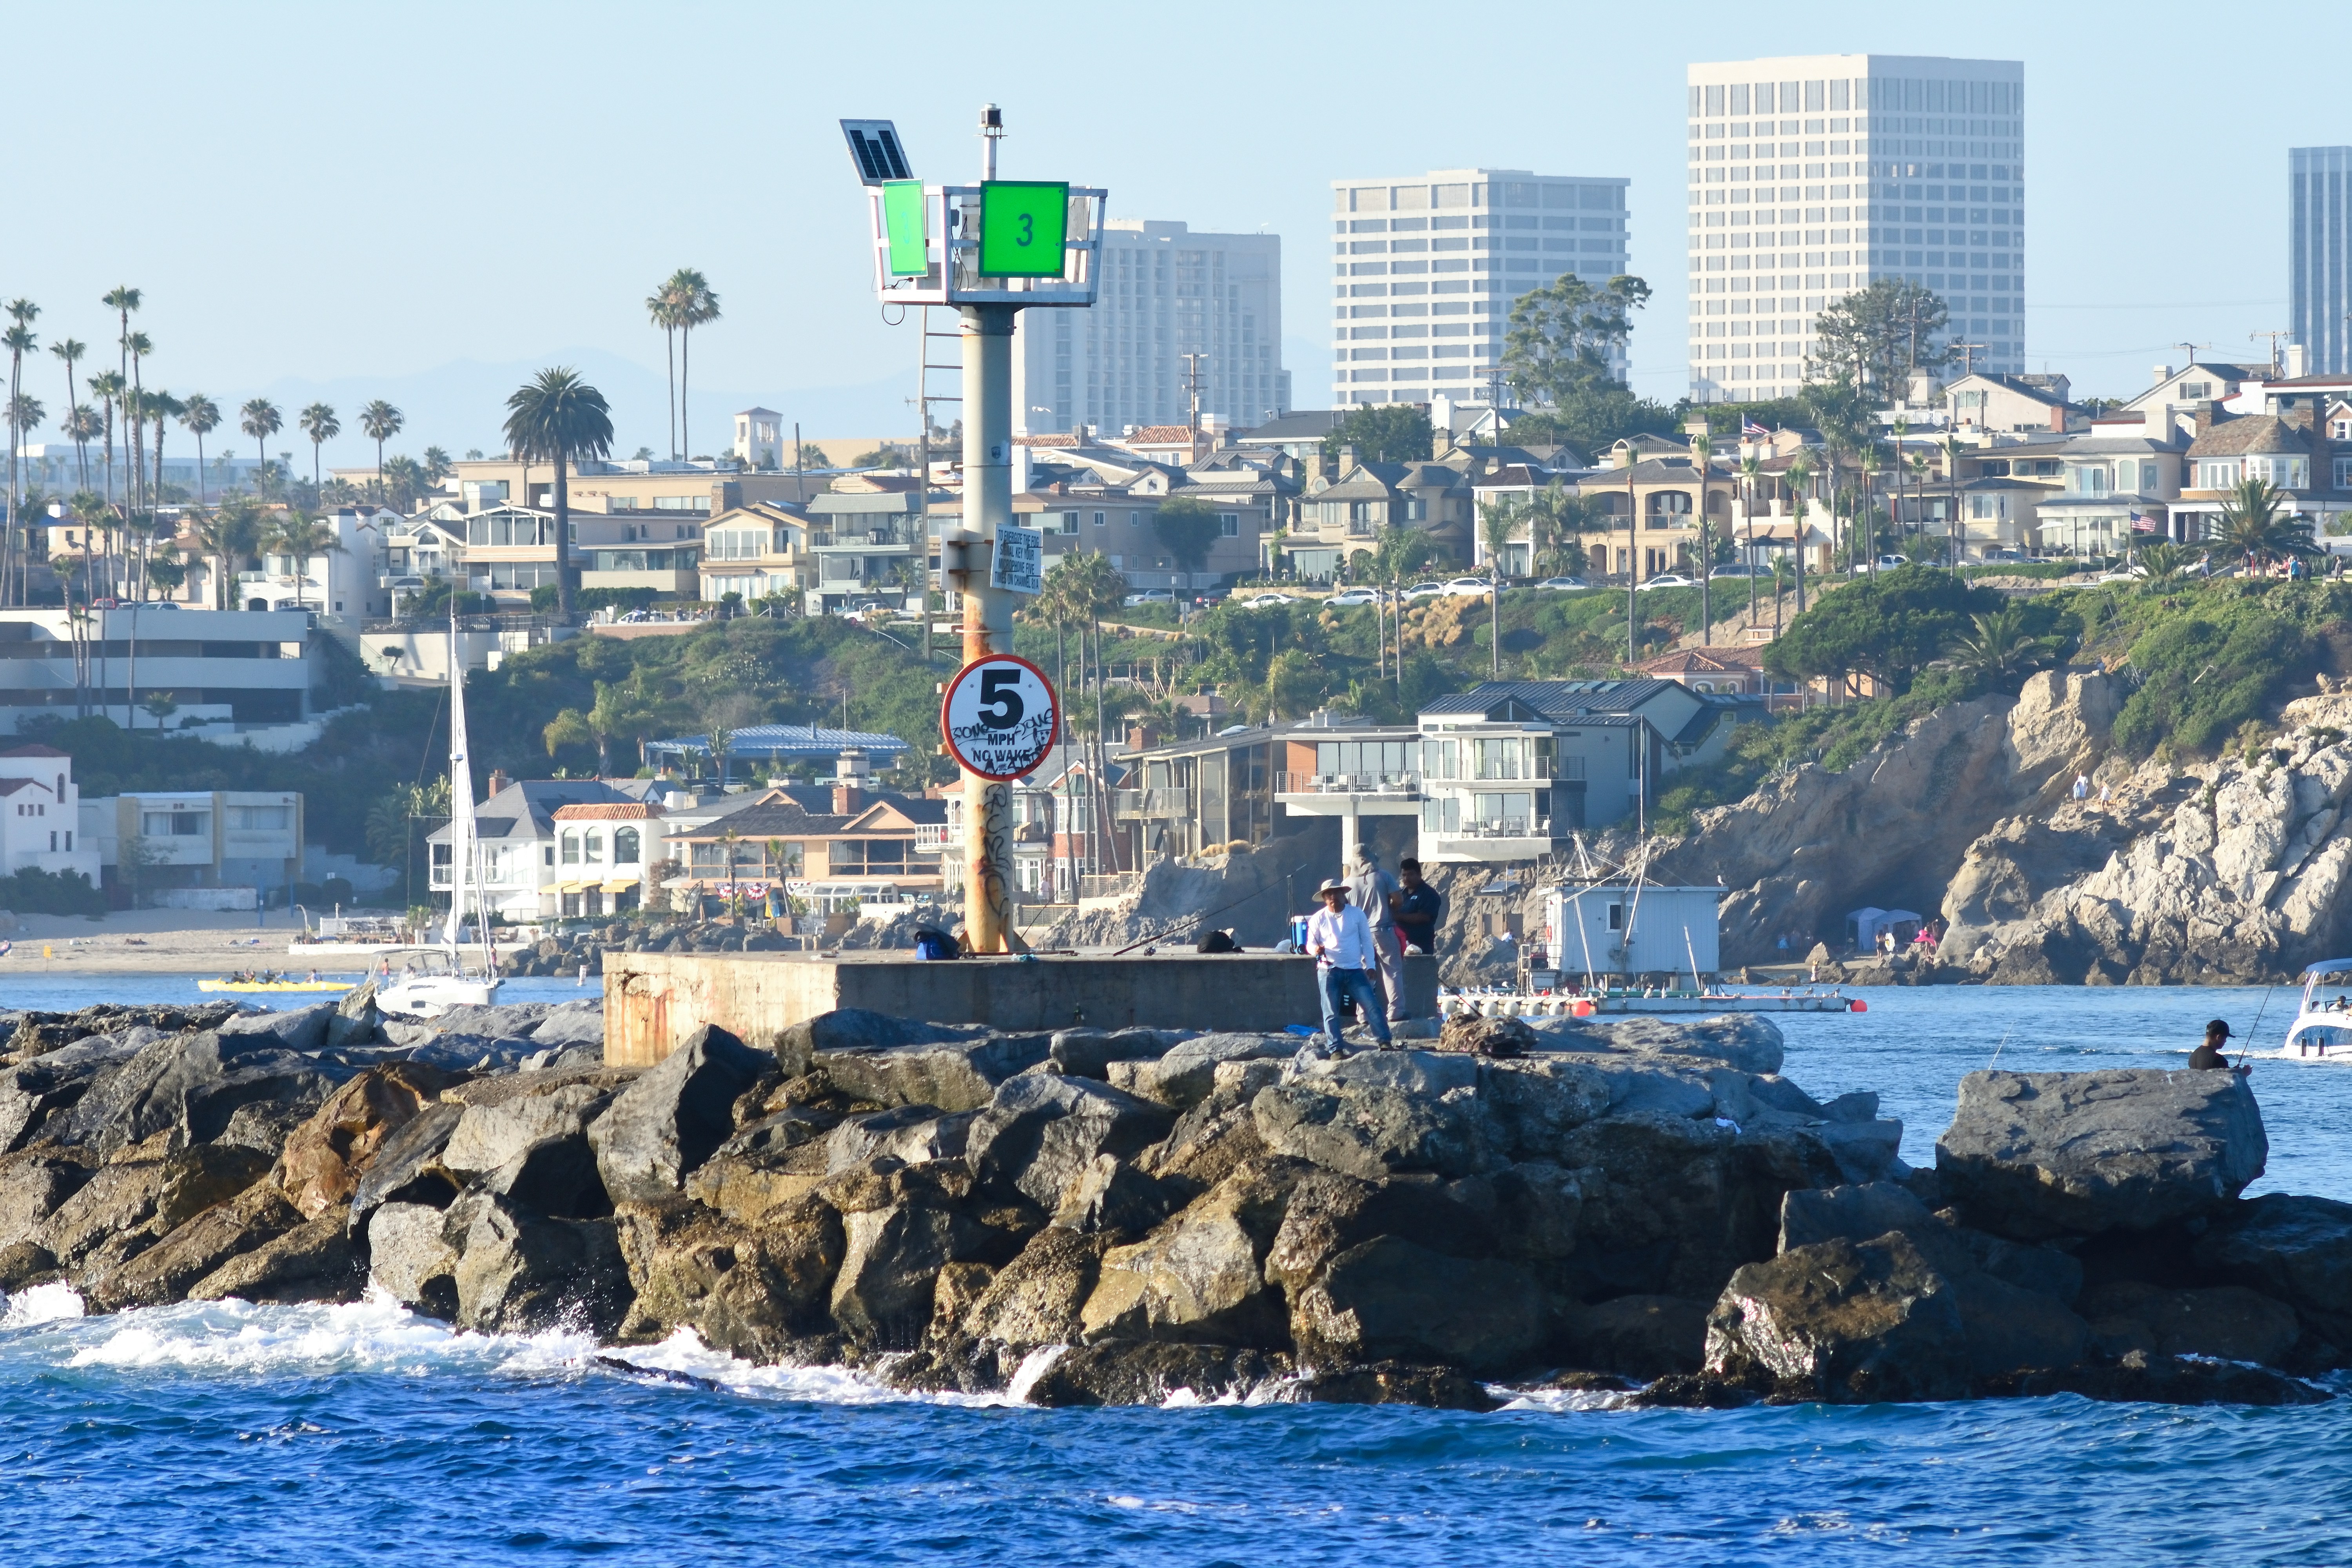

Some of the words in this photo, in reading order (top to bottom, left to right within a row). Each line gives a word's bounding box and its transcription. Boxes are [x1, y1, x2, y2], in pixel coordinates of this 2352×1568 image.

[902, 211, 910, 245] 3
[1016, 213, 1033, 247] 3
[998, 529, 1003, 541] TO
[1004, 530, 1022, 544] ENERGIZE
[1031, 535, 1039, 547] FOG
[1000, 543, 1014, 557] SIGNAL
[1024, 548, 1034, 561] YOUR
[998, 558, 1025, 573] MICROPHONE
[1025, 563, 1034, 575] FIVE
[995, 571, 1007, 584] TIMES
[1007, 573, 1013, 585] ON
[1014, 574, 1031, 588] CHANNEL
[978, 669, 1024, 730] 5
[987, 733, 1015, 746] MPH
[973, 750, 991, 762] NO
[994, 749, 1030, 762] WAKE
